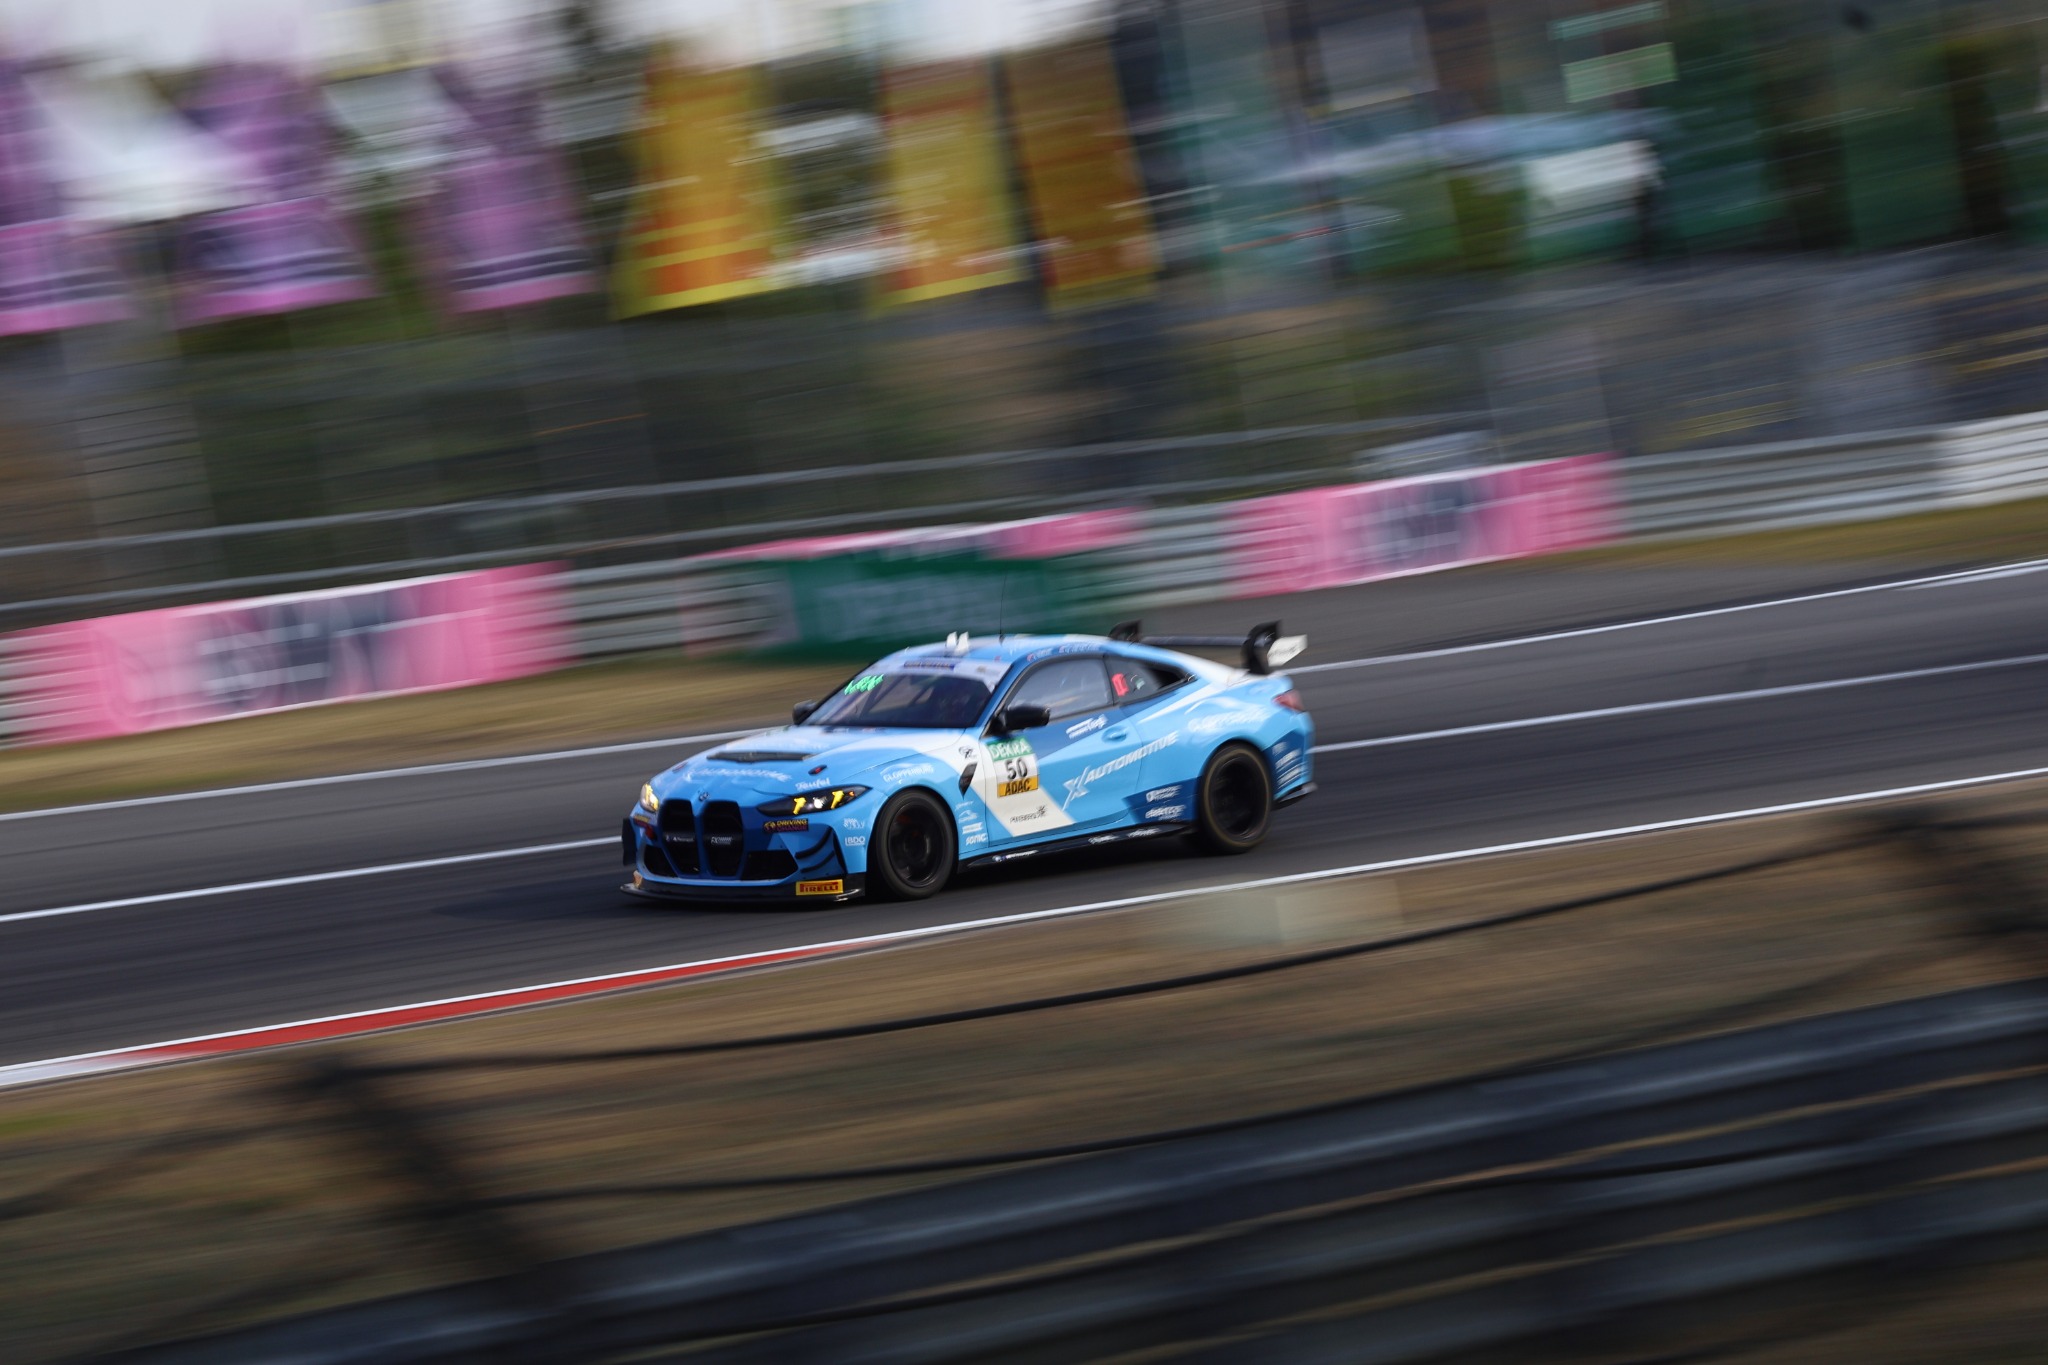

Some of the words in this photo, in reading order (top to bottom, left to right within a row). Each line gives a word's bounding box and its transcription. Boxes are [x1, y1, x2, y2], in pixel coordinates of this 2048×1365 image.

[990, 739, 1030, 759] DEKRA
[1084, 731, 1180, 784] AUTOMOTIVE
[1004, 757, 1028, 780] 50
[1004, 778, 1031, 796] ADAC
[776, 819, 807, 828] DRIVING
[800, 882, 839, 893] PIRELLI
